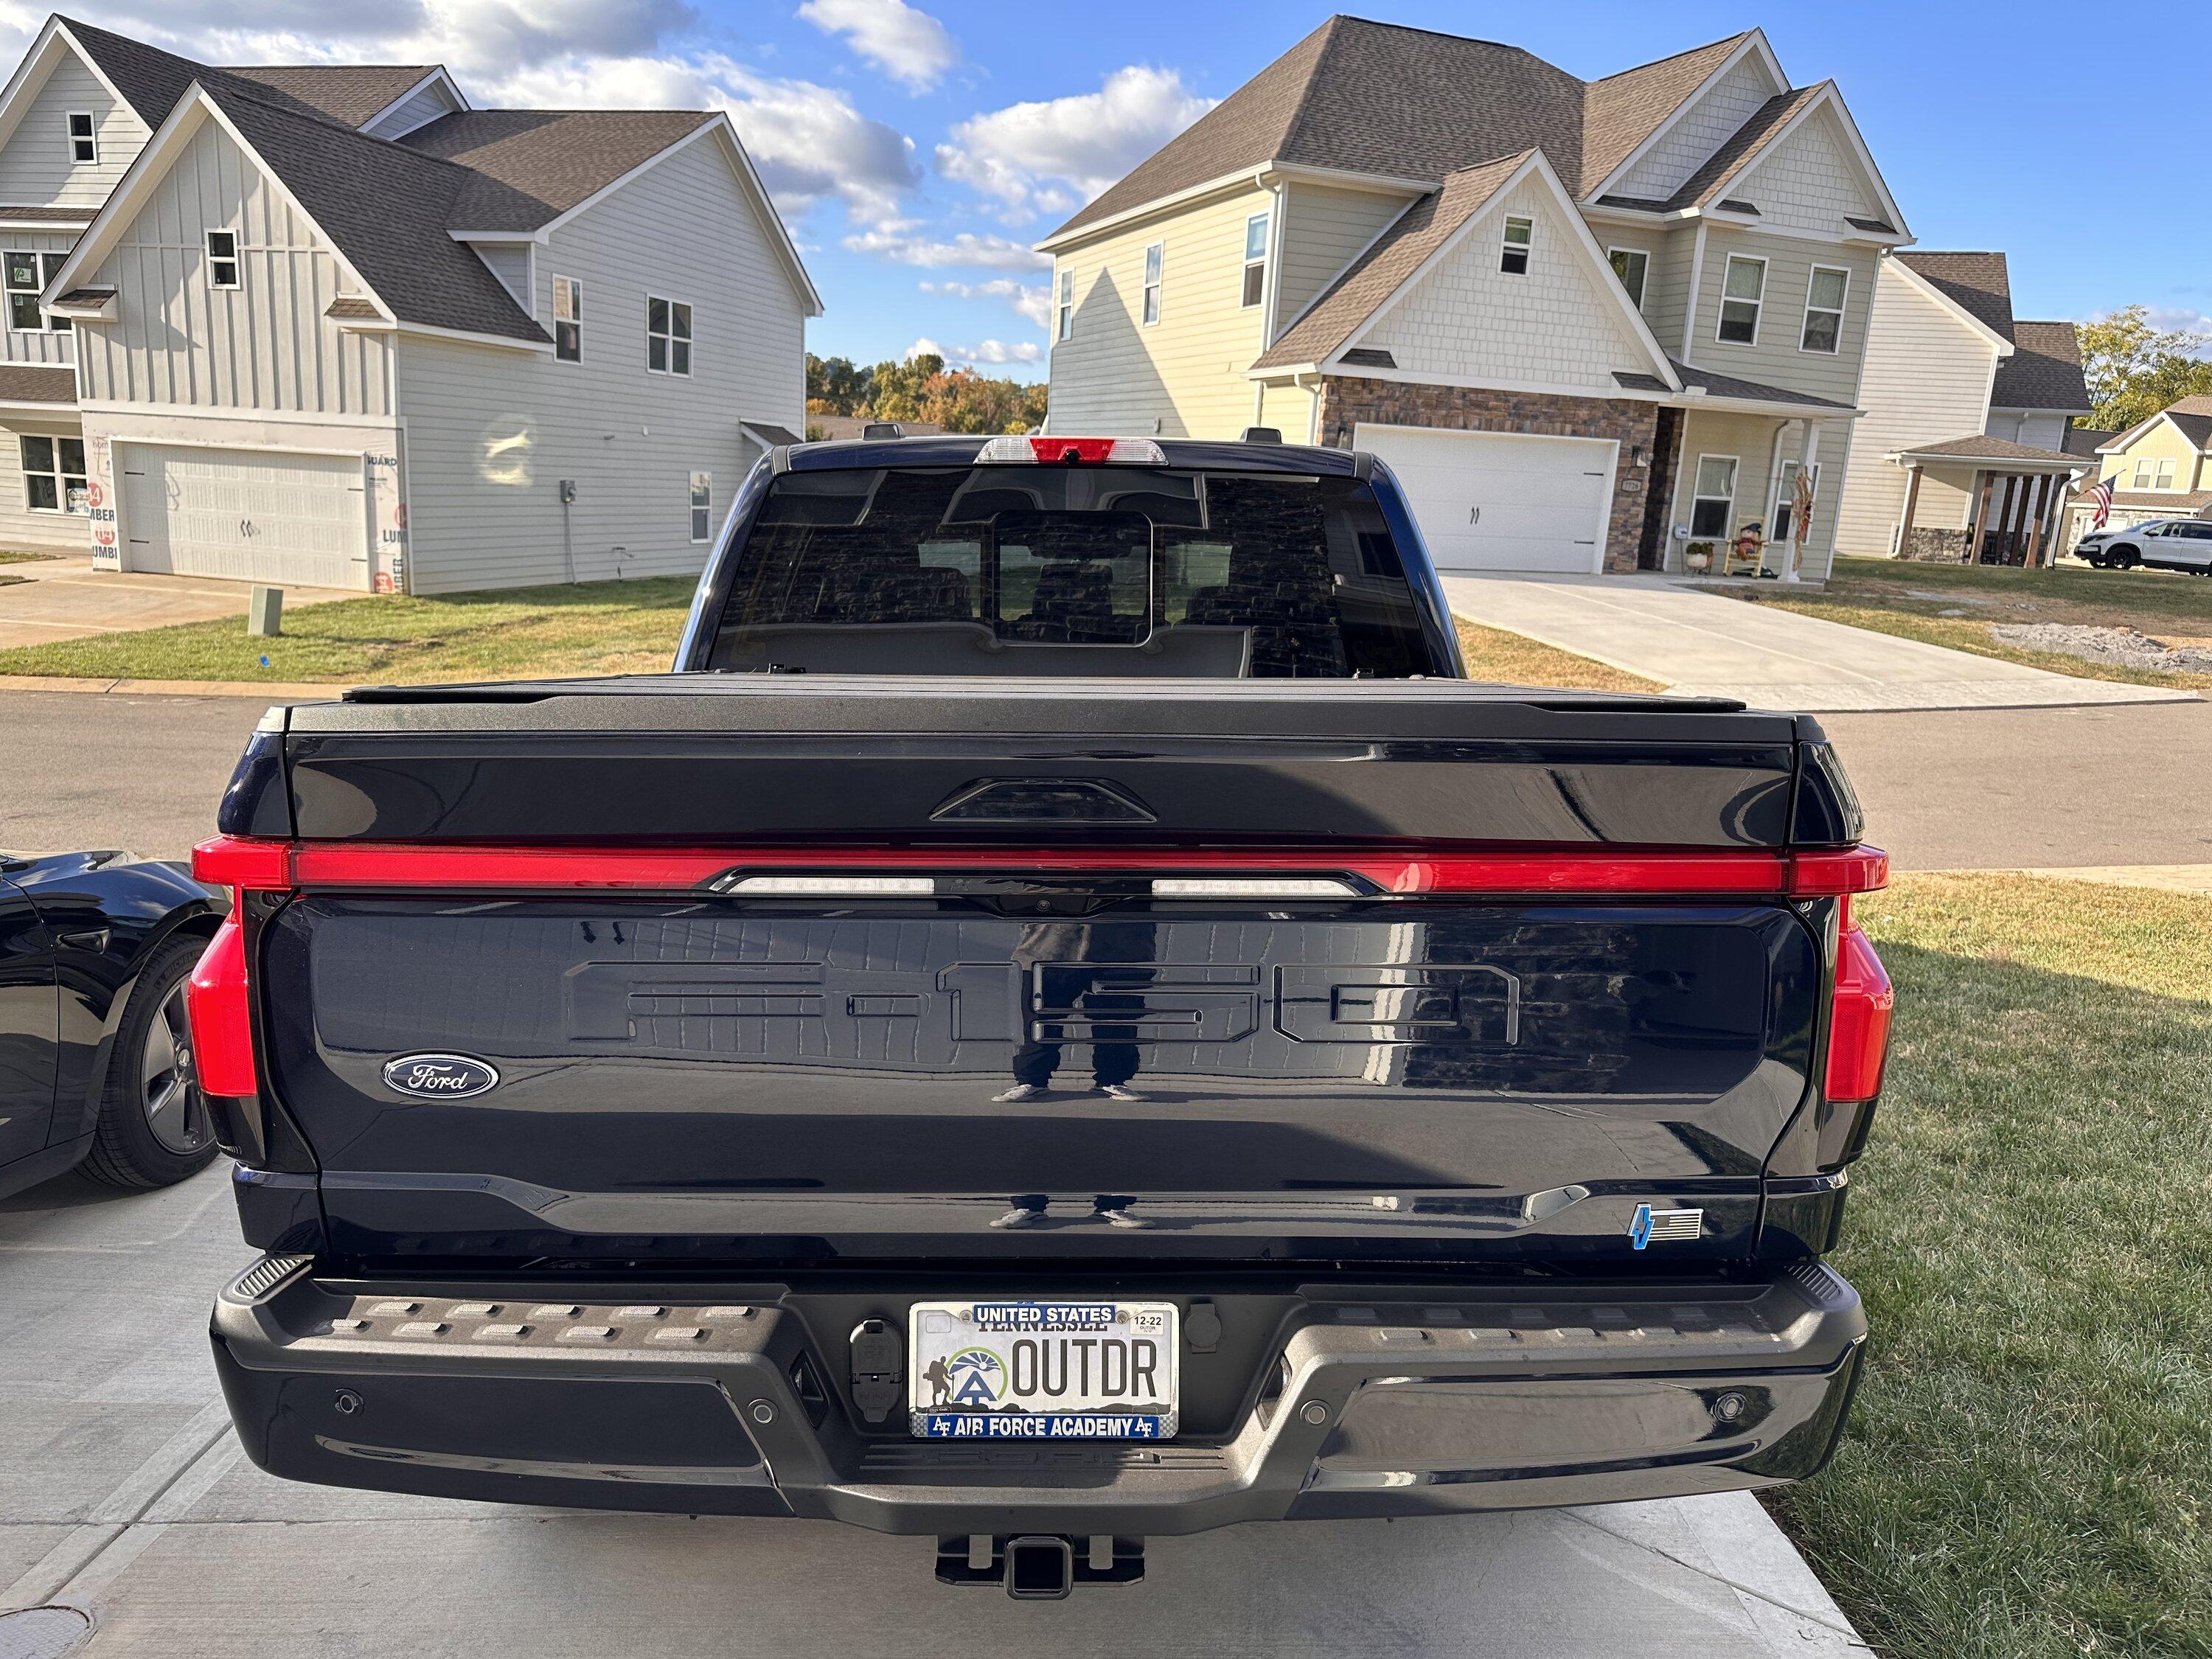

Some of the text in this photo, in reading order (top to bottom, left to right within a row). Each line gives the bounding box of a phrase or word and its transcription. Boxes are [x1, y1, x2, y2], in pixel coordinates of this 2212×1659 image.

[407, 1064, 468, 1090] Ford
[977, 1307, 1112, 1322] UNITED STATES
[1134, 1316, 1161, 1326] 12-22
[1011, 1338, 1158, 1397] OUTDR
[954, 1417, 984, 1436] AIR
[989, 1417, 1046, 1436] FORCE
[1050, 1417, 1133, 1436] ACADEMY
